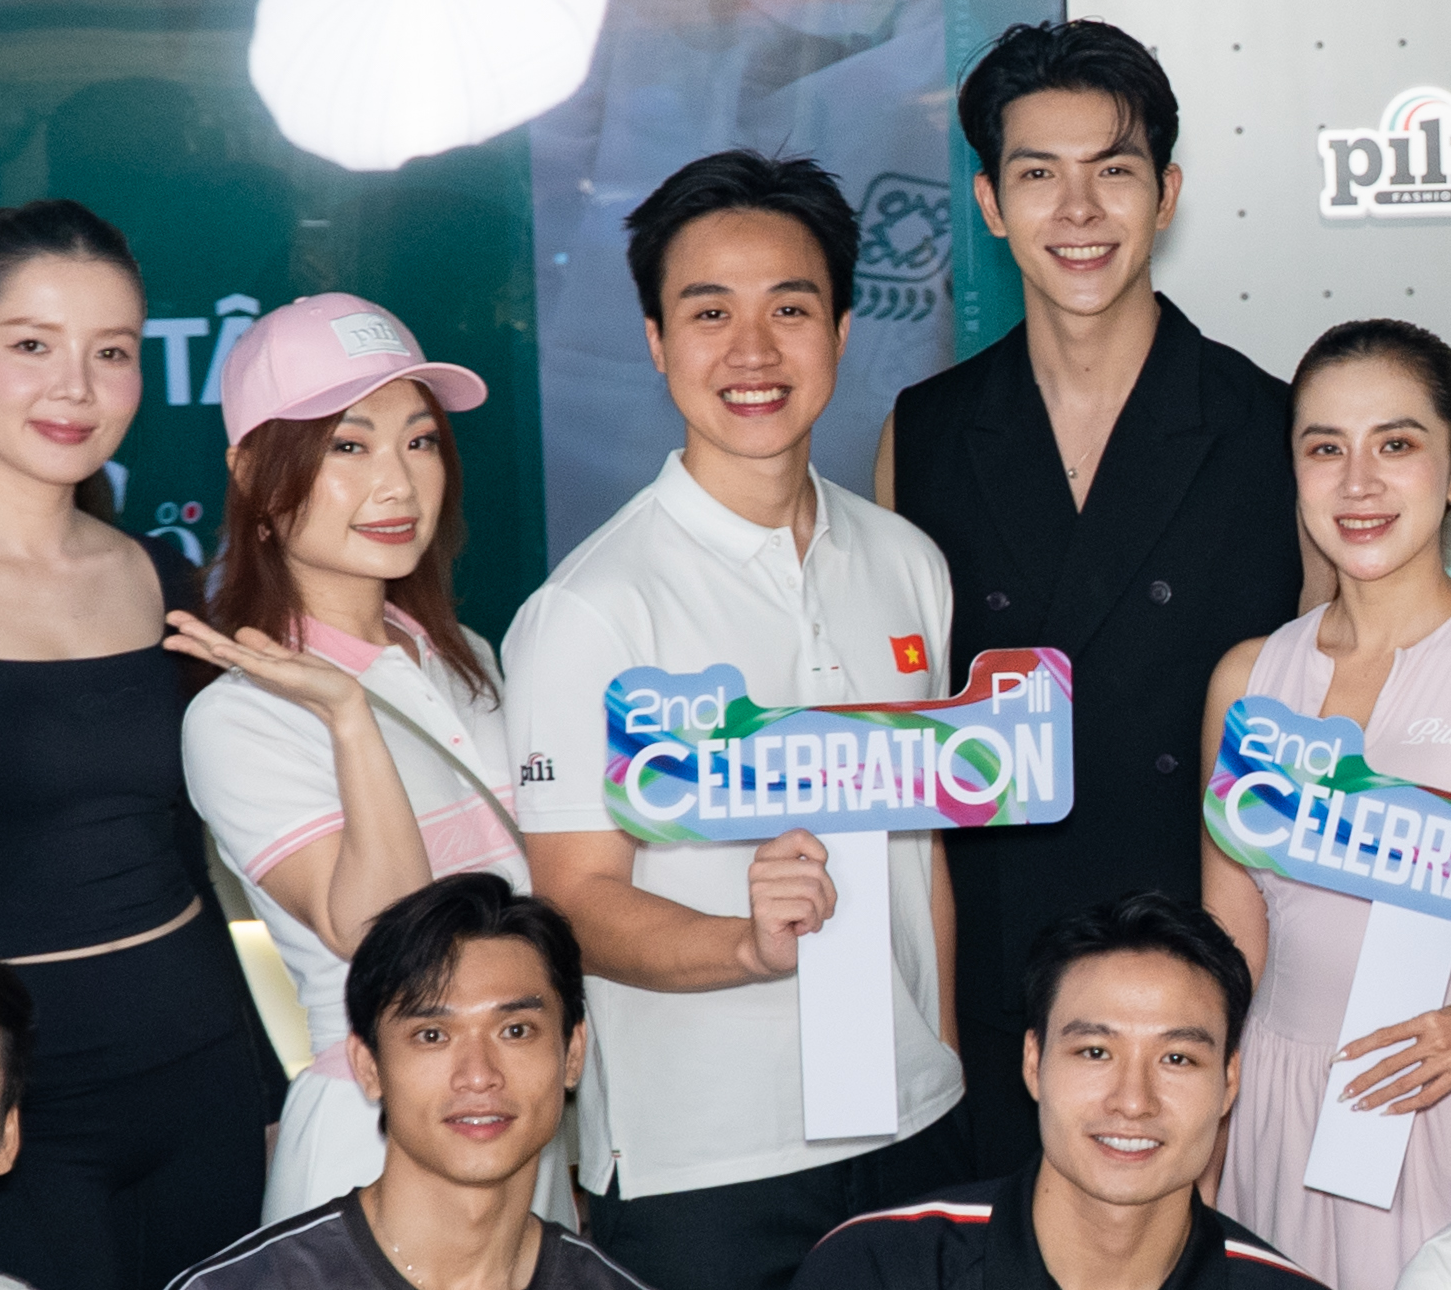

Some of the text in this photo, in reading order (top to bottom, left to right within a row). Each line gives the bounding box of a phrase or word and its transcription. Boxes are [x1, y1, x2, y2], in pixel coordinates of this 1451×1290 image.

[624, 671, 1051, 735] 2nd Pili
[520, 758, 556, 787] pili
[624, 722, 1055, 822] CELEBRATION
[1238, 715, 1342, 779] 2nd
